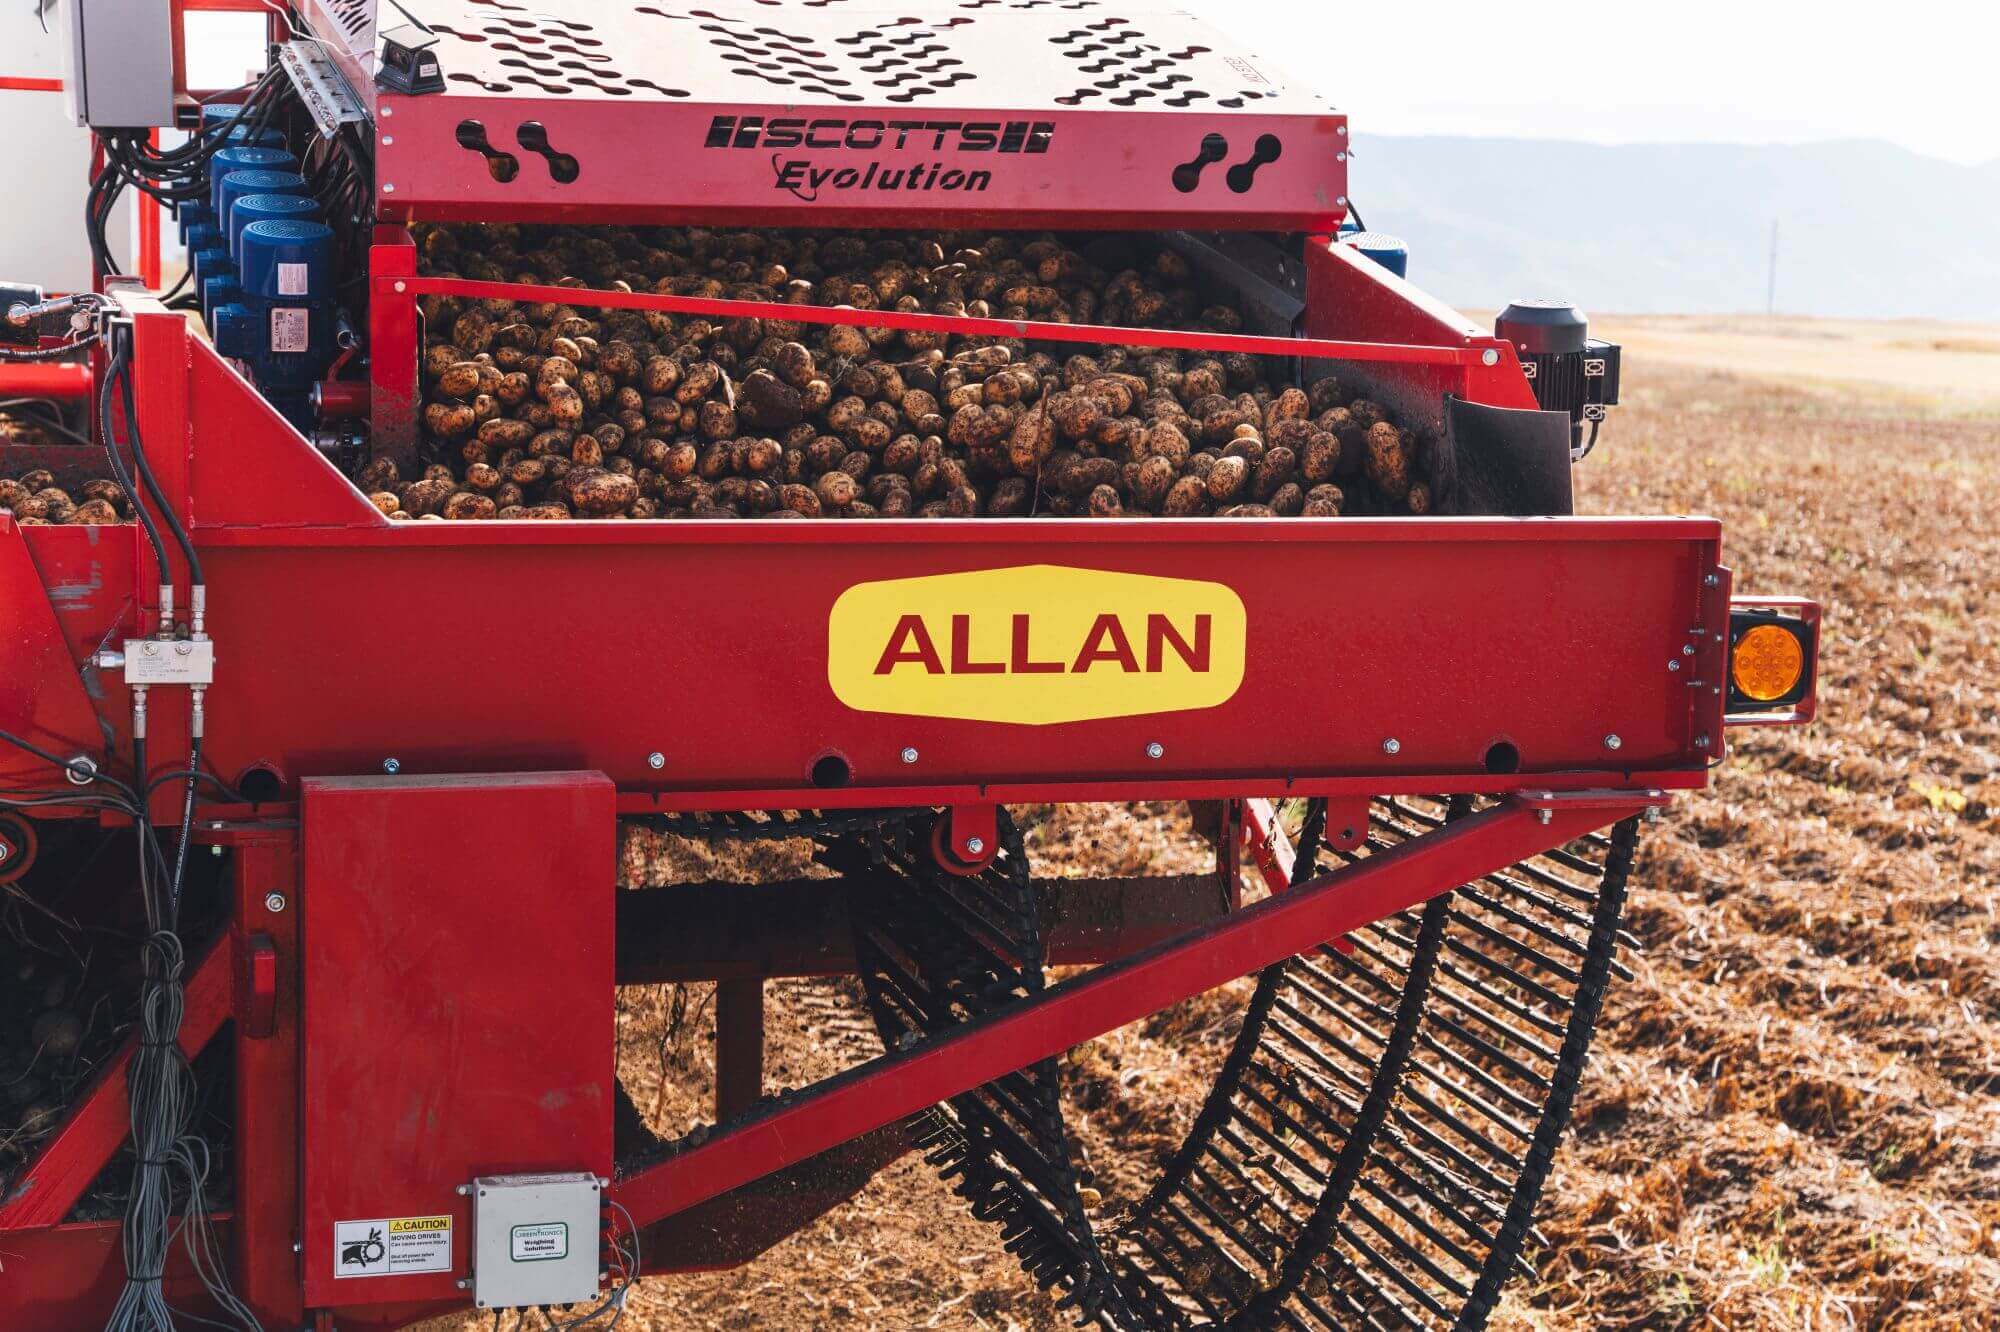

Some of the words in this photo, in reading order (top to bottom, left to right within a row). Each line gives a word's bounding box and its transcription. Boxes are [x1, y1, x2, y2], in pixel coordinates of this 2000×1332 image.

[762, 118, 1002, 152] SCOTTS
[773, 159, 992, 195] Evolution
[873, 613, 1212, 675] ALLAN
[403, 1219, 447, 1230] CAUTION
